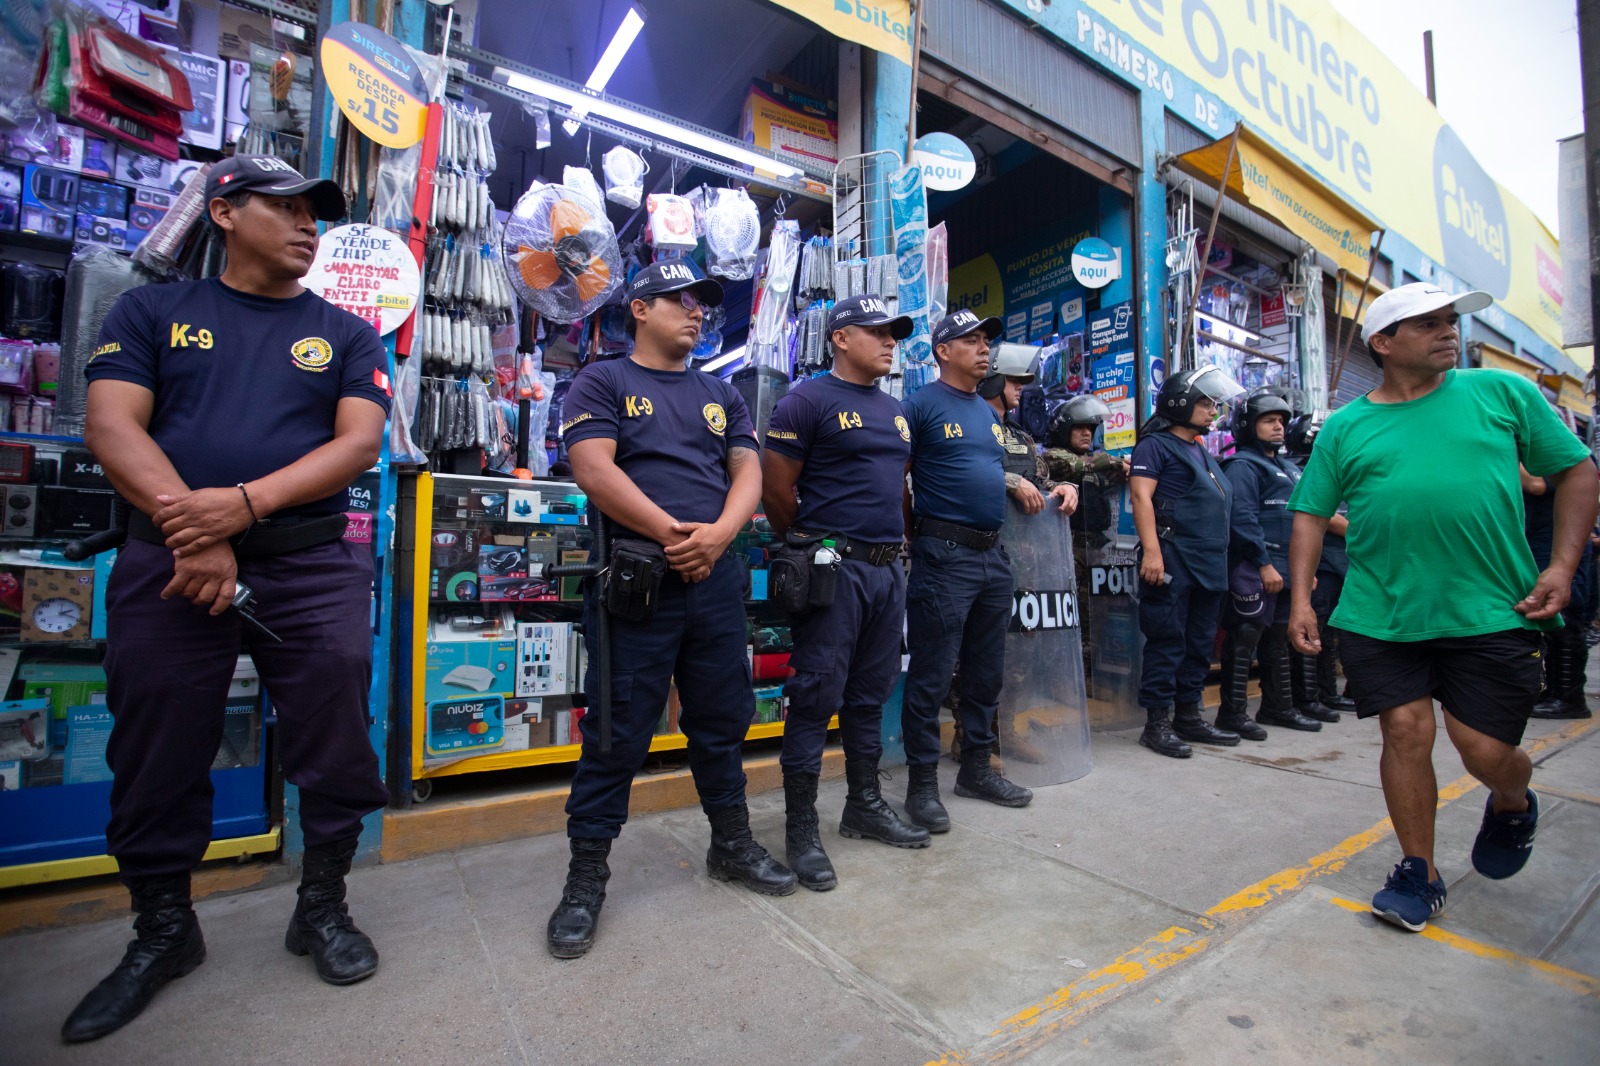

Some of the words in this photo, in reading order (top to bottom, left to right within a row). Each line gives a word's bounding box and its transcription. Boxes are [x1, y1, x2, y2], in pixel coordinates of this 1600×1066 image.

[855, 0, 915, 47] bitel
[350, 28, 411, 74] DIRECTV
[1076, 9, 1175, 101] PRIMERO
[1194, 92, 1219, 132] DE
[348, 62, 406, 105] RECARGA
[356, 78, 397, 110] DESDE
[1181, 0, 1373, 194] Octubre
[1241, 157, 1269, 191] bitel
[1271, 184, 1293, 209] VENTA
[1293, 201, 1304, 217] DE
[1302, 209, 1342, 242] ACCESORIOS
[348, 225, 371, 238] SE
[1460, 186, 1507, 267] bitel
[335, 236, 392, 251] VENDE
[331, 247, 372, 261] CHIP
[1006, 252, 1040, 274] PUNTO
[1041, 246, 1055, 259] DE
[1029, 256, 1065, 278] ROSITA
[336, 276, 382, 290] CLARO
[633, 277, 650, 290] PERU
[1011, 282, 1031, 295] VENTA
[1031, 278, 1041, 288] DE
[384, 297, 409, 306] bitel
[170, 322, 213, 350] K-9
[1092, 329, 1116, 340] Compra
[1112, 331, 1129, 341] Entel
[1096, 372, 1105, 380] tu
[1105, 368, 1124, 378] chip
[1096, 378, 1117, 389] Entel
[625, 395, 654, 418] K-9
[838, 411, 863, 430] K-9
[944, 423, 964, 440] K-9
[74, 713, 110, 721] HA-71
[447, 703, 485, 715] niubiz
